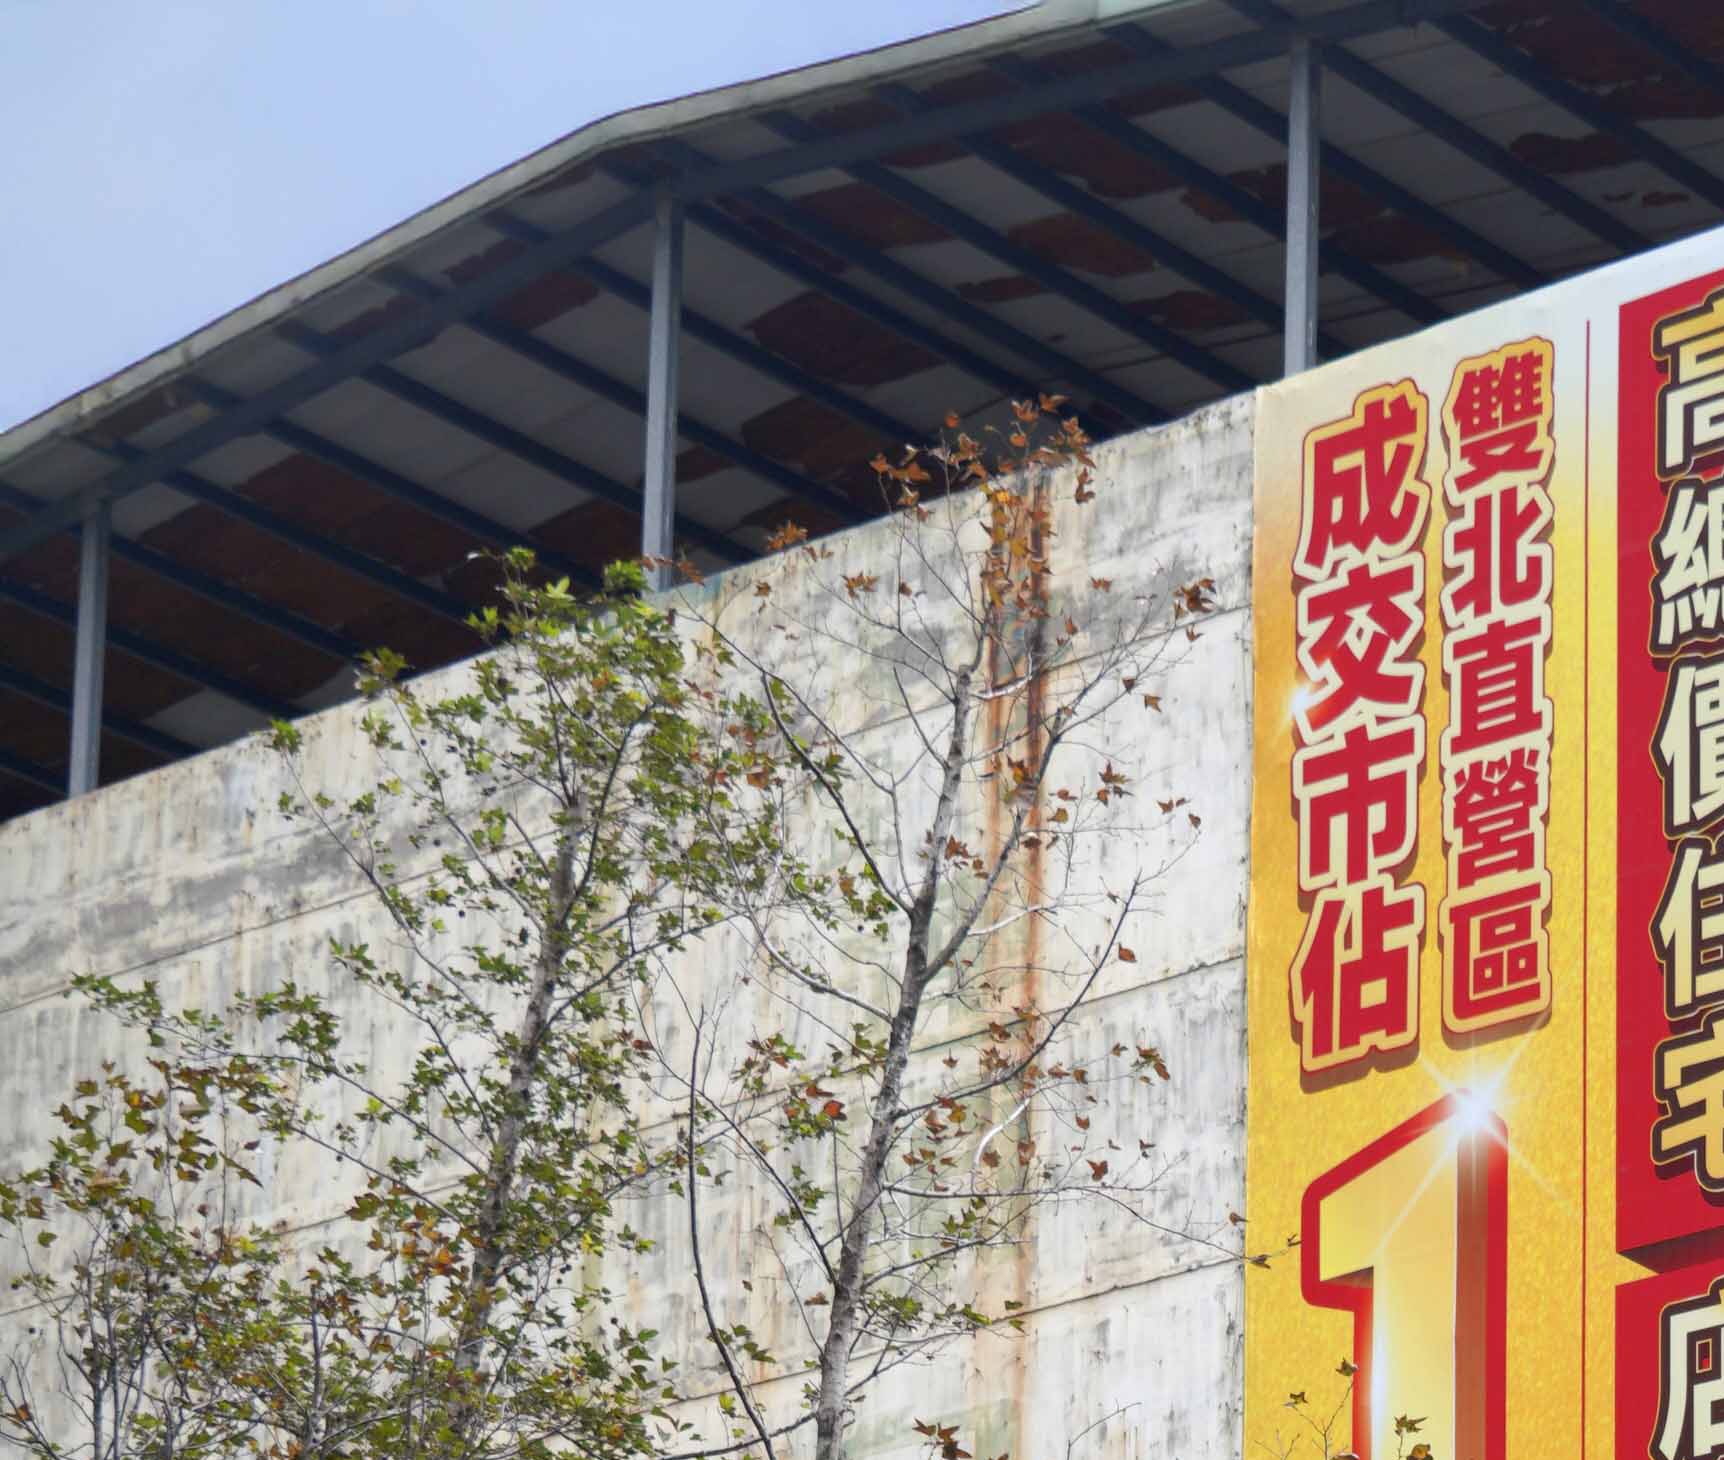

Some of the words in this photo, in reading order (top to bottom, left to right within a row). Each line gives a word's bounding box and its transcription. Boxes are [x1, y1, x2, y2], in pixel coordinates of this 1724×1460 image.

[1299, 384, 1422, 1064] 成交市佔
[1447, 344, 1552, 1020] 雙北直營區
